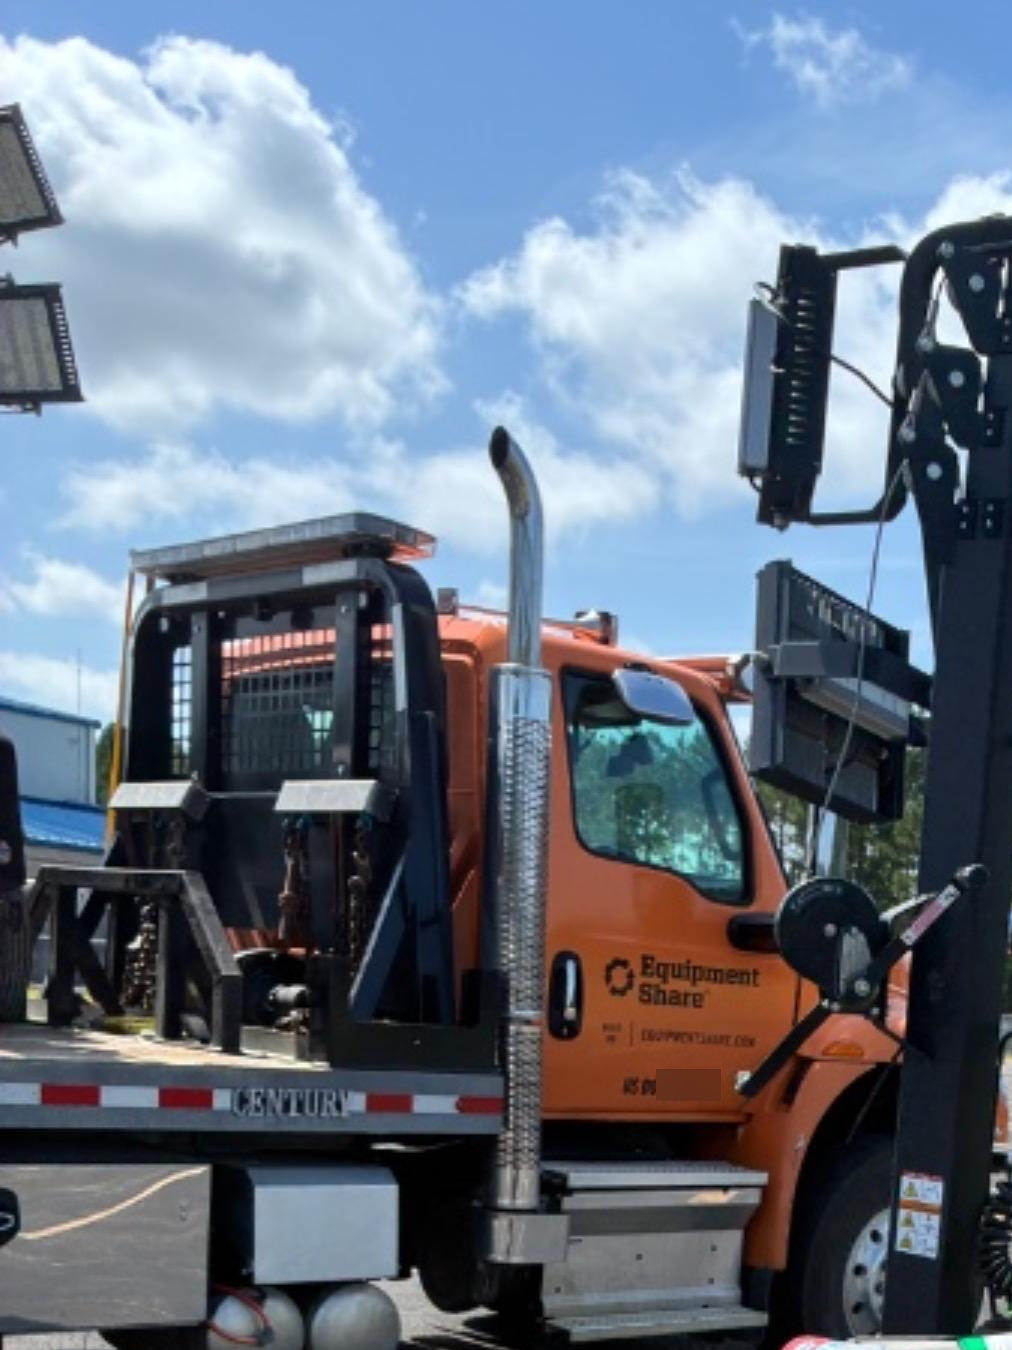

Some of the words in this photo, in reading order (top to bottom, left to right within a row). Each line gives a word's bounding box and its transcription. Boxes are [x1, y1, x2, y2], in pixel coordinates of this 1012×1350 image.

[640, 954, 760, 987] Equipment
[638, 983, 705, 1009] Share
[231, 1088, 350, 1117] CENTURY
